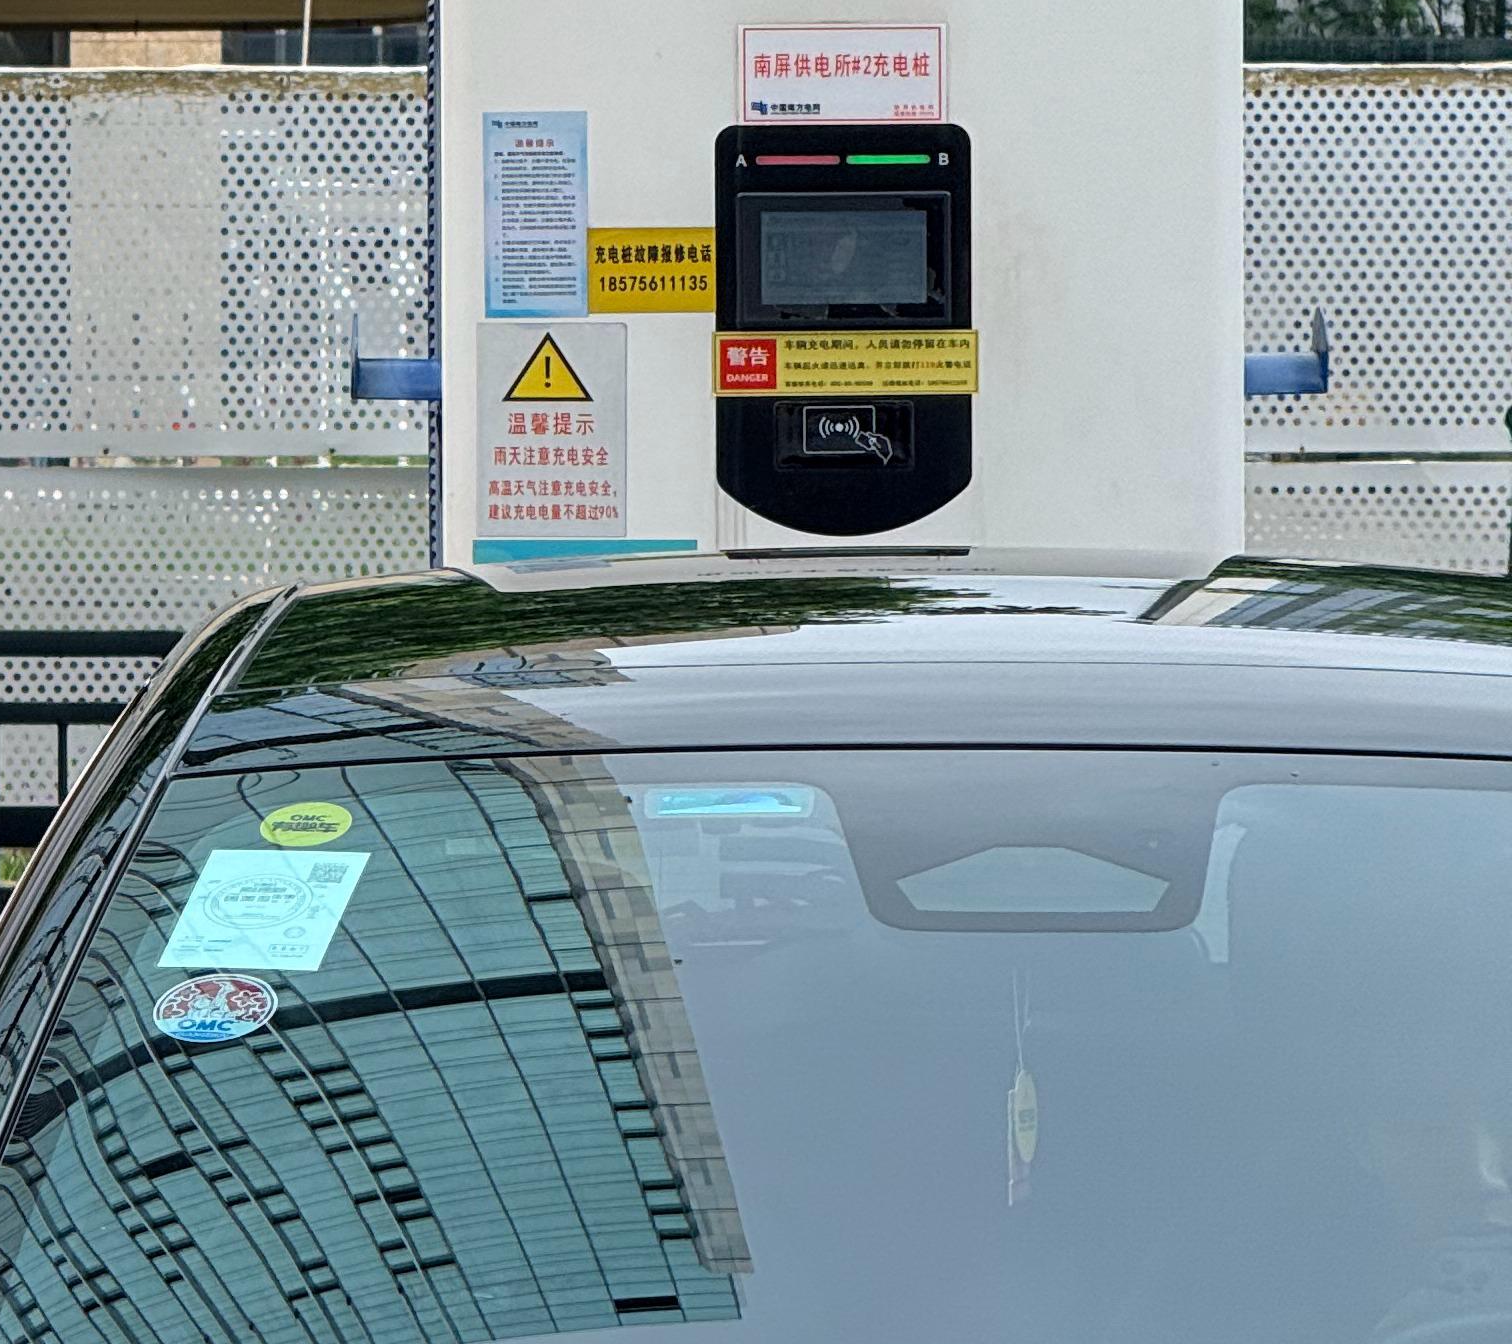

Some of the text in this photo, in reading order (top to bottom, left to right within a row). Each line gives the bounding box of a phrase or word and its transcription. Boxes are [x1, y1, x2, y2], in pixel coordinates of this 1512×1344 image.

[753, 52, 930, 78] 南屏供电所#2充电桩
[735, 152, 950, 168] A B
[595, 243, 712, 264] 充电桩故障报修电话
[599, 275, 708, 292] 18575611135
[727, 346, 770, 366] 警告
[726, 373, 769, 383] DANGER
[508, 412, 594, 435] 温馨提示
[494, 446, 609, 466] 雨天注意充电安全
[178, 1019, 234, 1031] OMC
